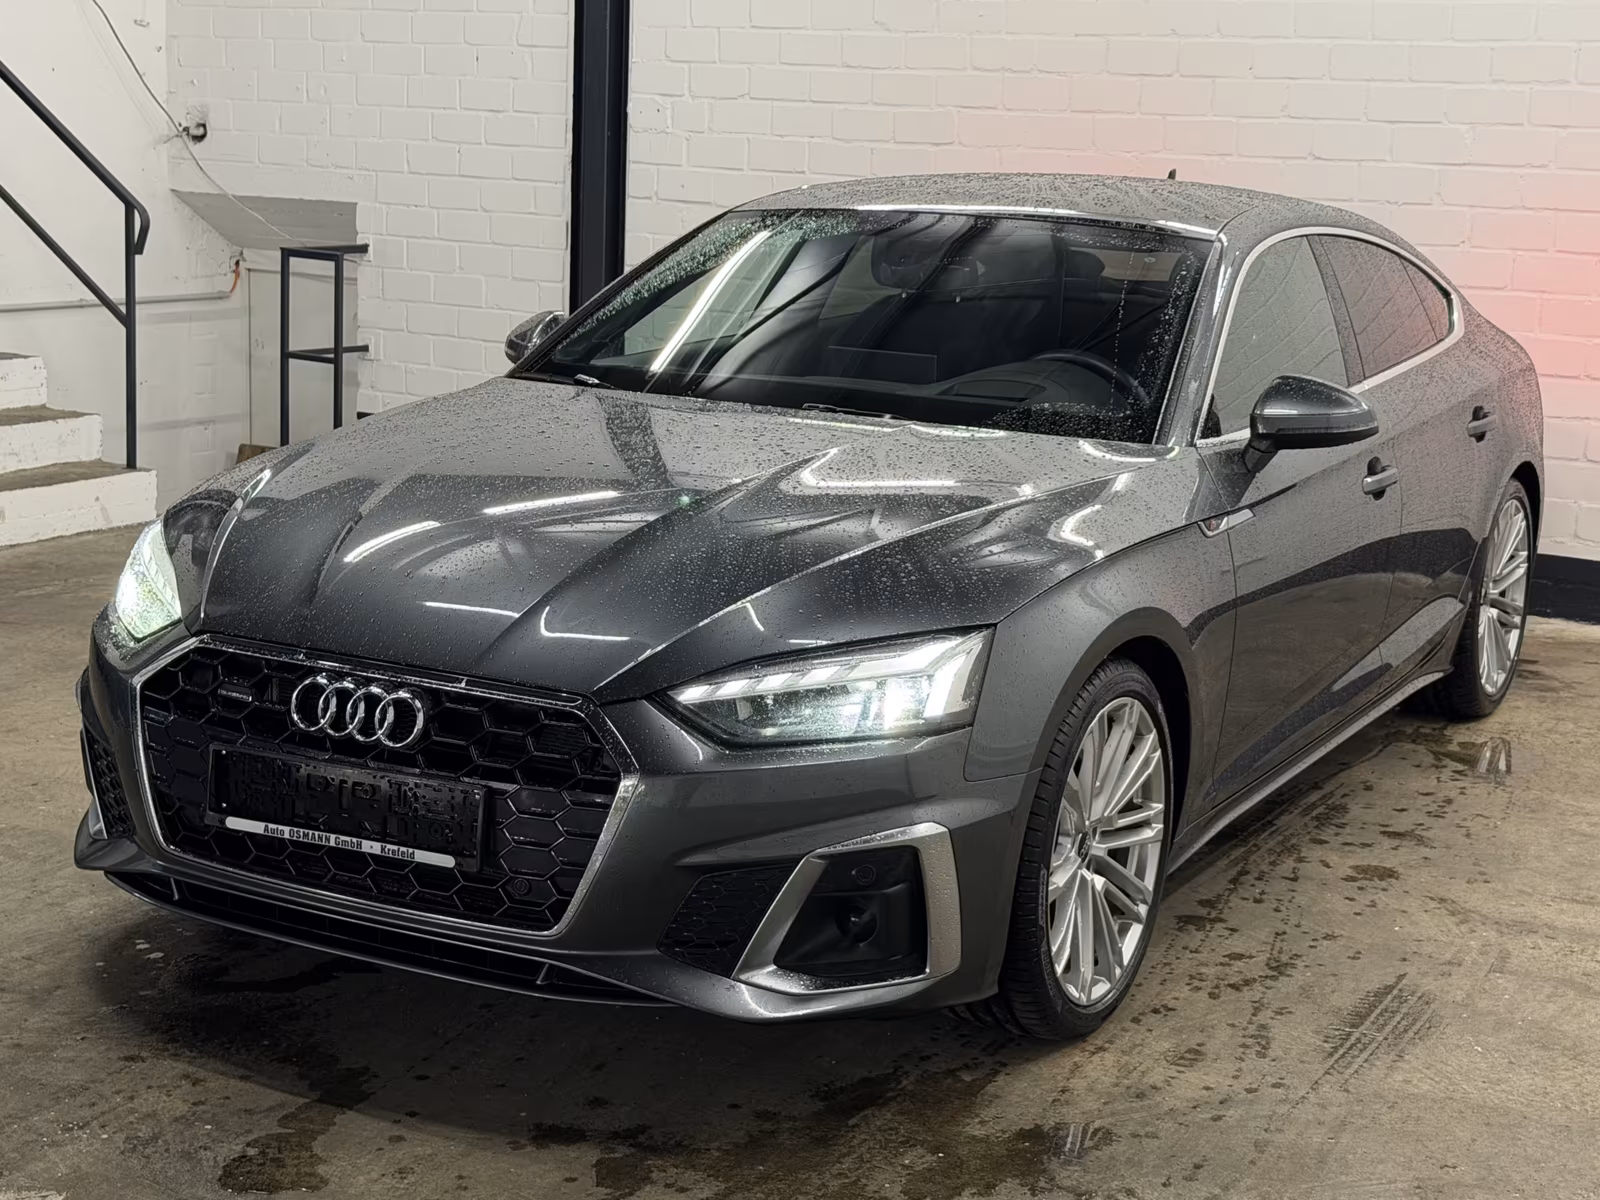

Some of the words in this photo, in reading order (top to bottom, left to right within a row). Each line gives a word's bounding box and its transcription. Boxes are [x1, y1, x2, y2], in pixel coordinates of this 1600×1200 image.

[263, 824, 285, 837] Auto
[288, 828, 331, 845] OSMANN
[334, 836, 363, 850] GmbH
[380, 844, 416, 860] Krefeld
